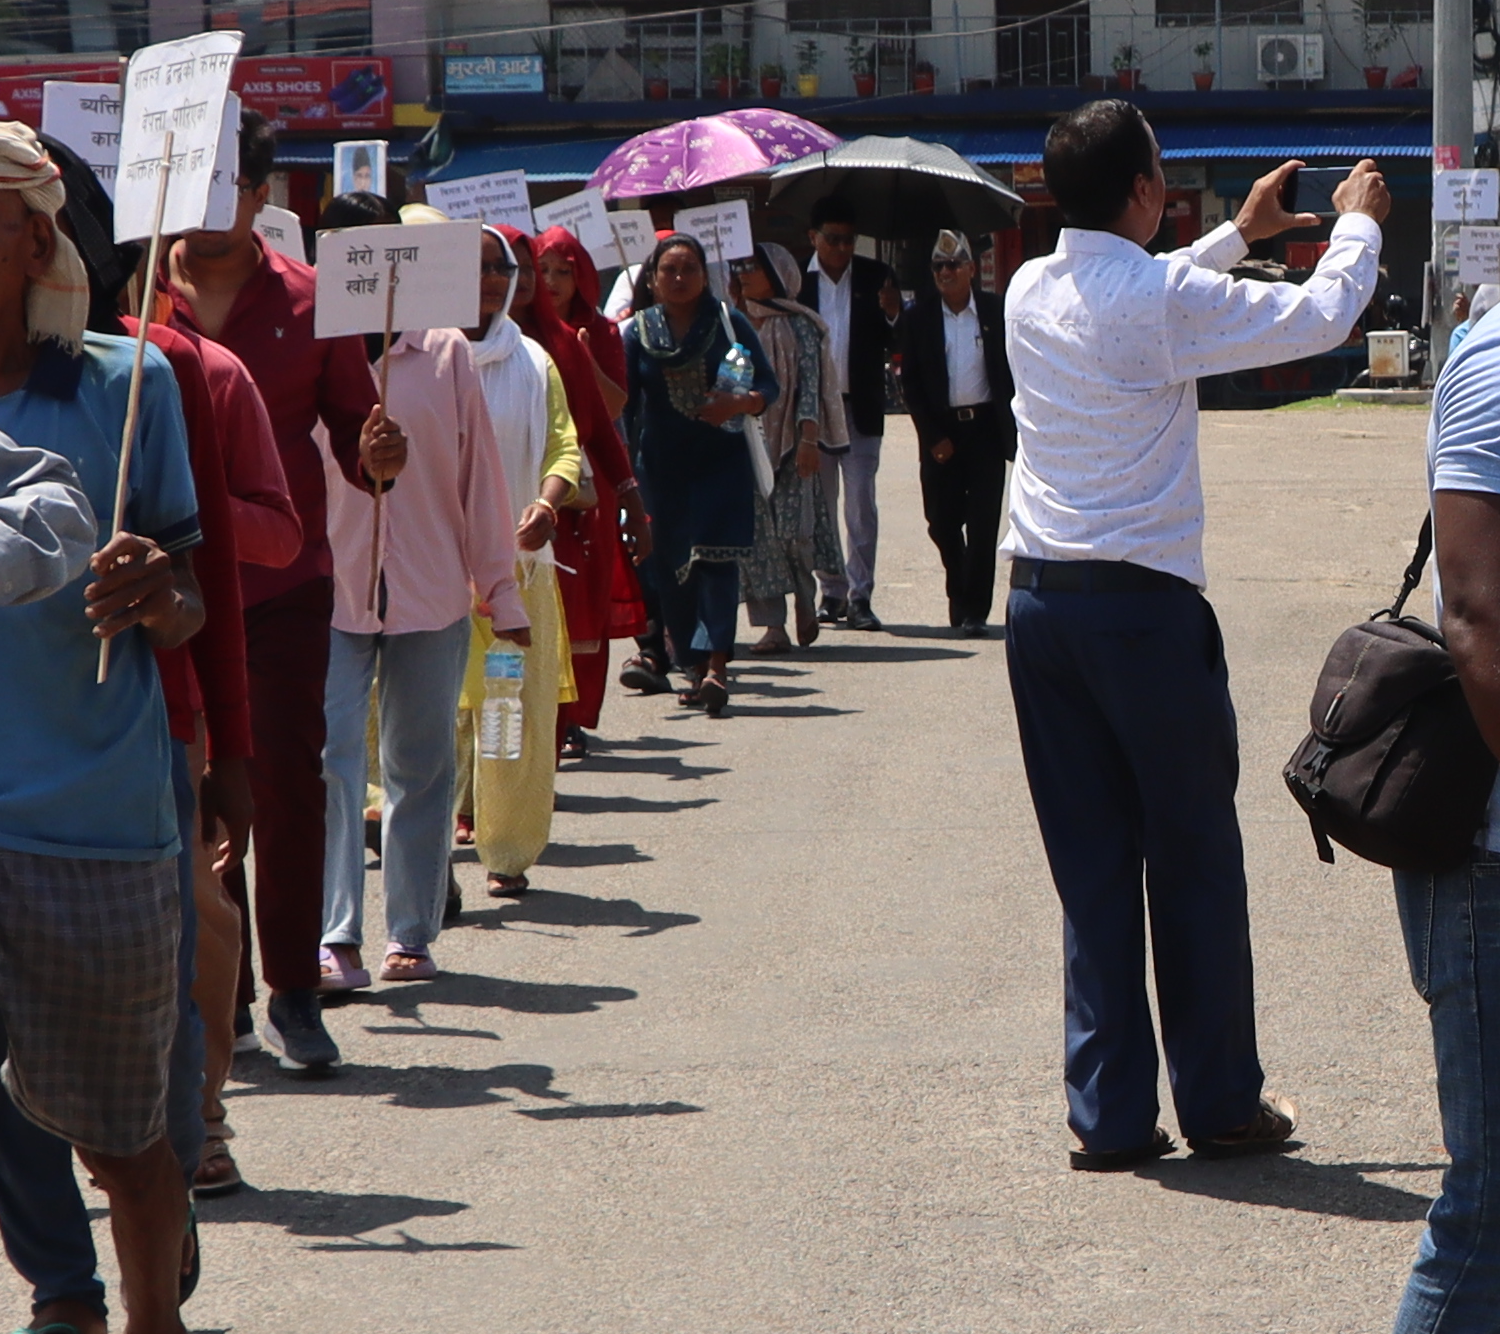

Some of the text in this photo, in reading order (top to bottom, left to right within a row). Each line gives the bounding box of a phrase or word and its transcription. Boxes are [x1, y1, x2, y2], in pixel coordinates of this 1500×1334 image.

[11, 88, 41, 100] AXIS
[243, 81, 321, 93] AXIS SHOES
[346, 244, 374, 266] मेरो
[346, 272, 379, 296] खोई
